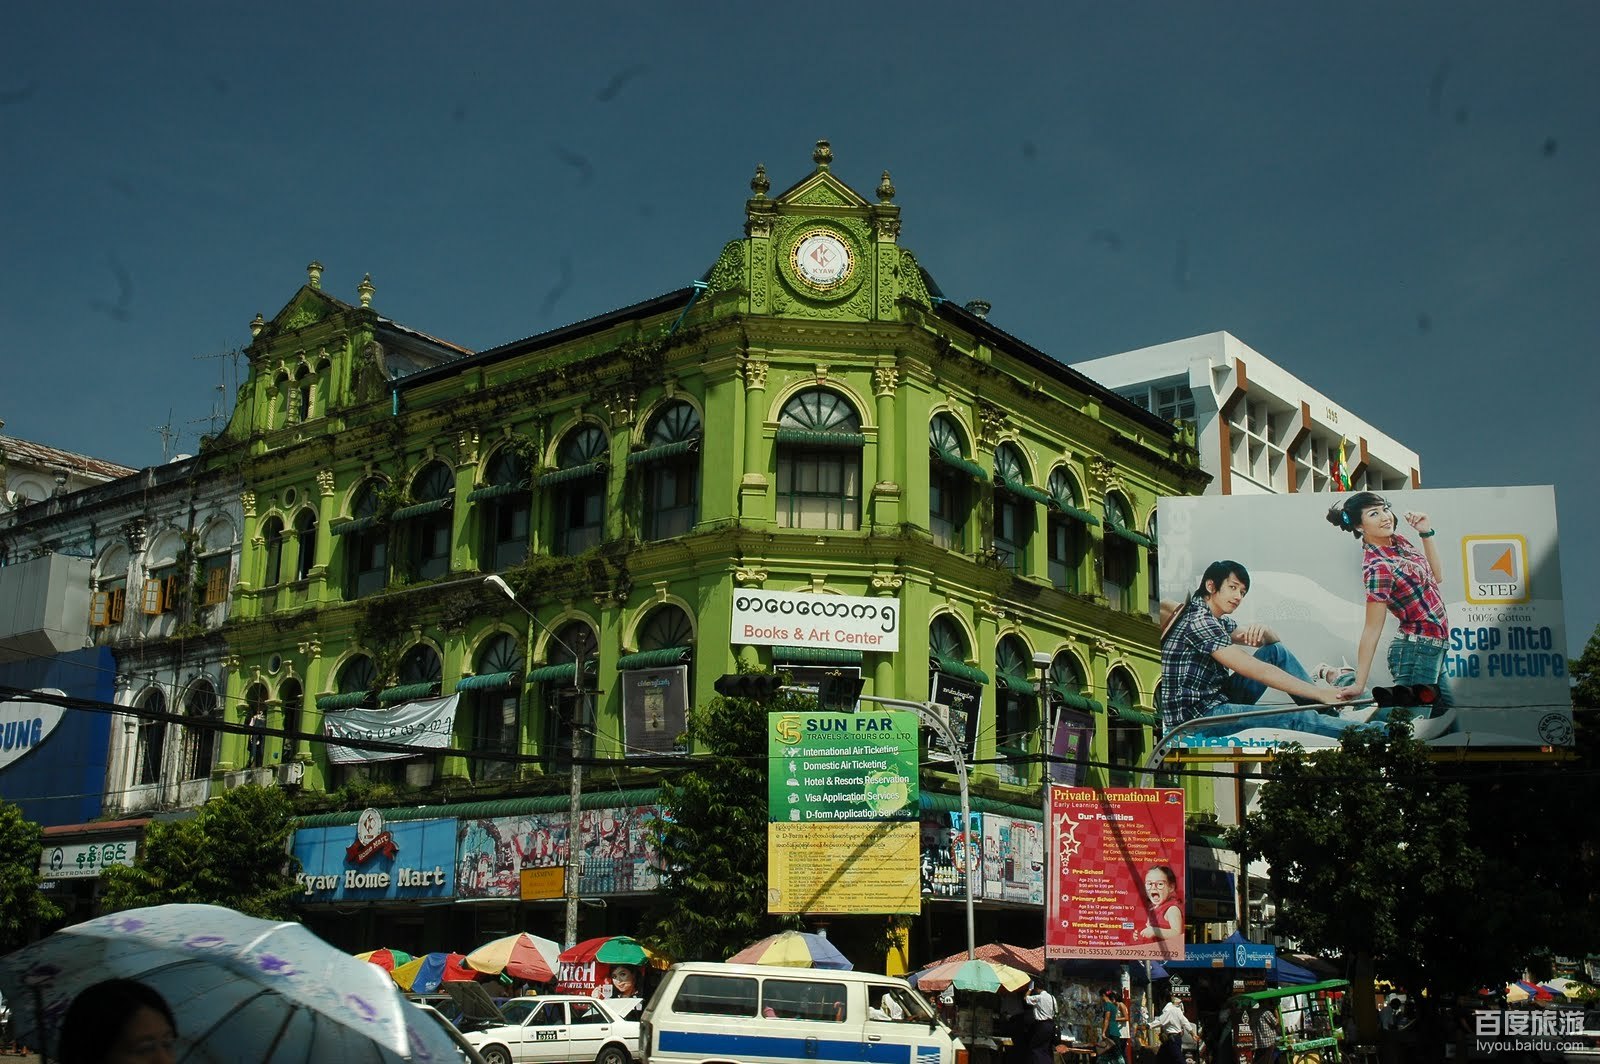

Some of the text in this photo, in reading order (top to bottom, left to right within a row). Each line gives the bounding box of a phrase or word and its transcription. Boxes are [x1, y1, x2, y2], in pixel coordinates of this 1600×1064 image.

[1478, 584, 1517, 596] STEP
[1467, 613, 1531, 622] 100% Cotton
[744, 625, 883, 645] Books & Art Center
[806, 718, 893, 731] SUN FAR
[803, 745, 899, 757] International Air Ticketing
[803, 760, 887, 770] Domestic Air Ticketing
[804, 775, 910, 786] Hotel & Resorts Reservation
[805, 791, 900, 803] Visa Application Services
[1054, 789, 1160, 803] Private International
[1054, 801, 1070, 809] Early
[806, 808, 912, 820] D-form Application Services
[45, 869, 96, 878] ELECTRONICS
[344, 869, 390, 889] Home
[397, 866, 445, 887] Mart
